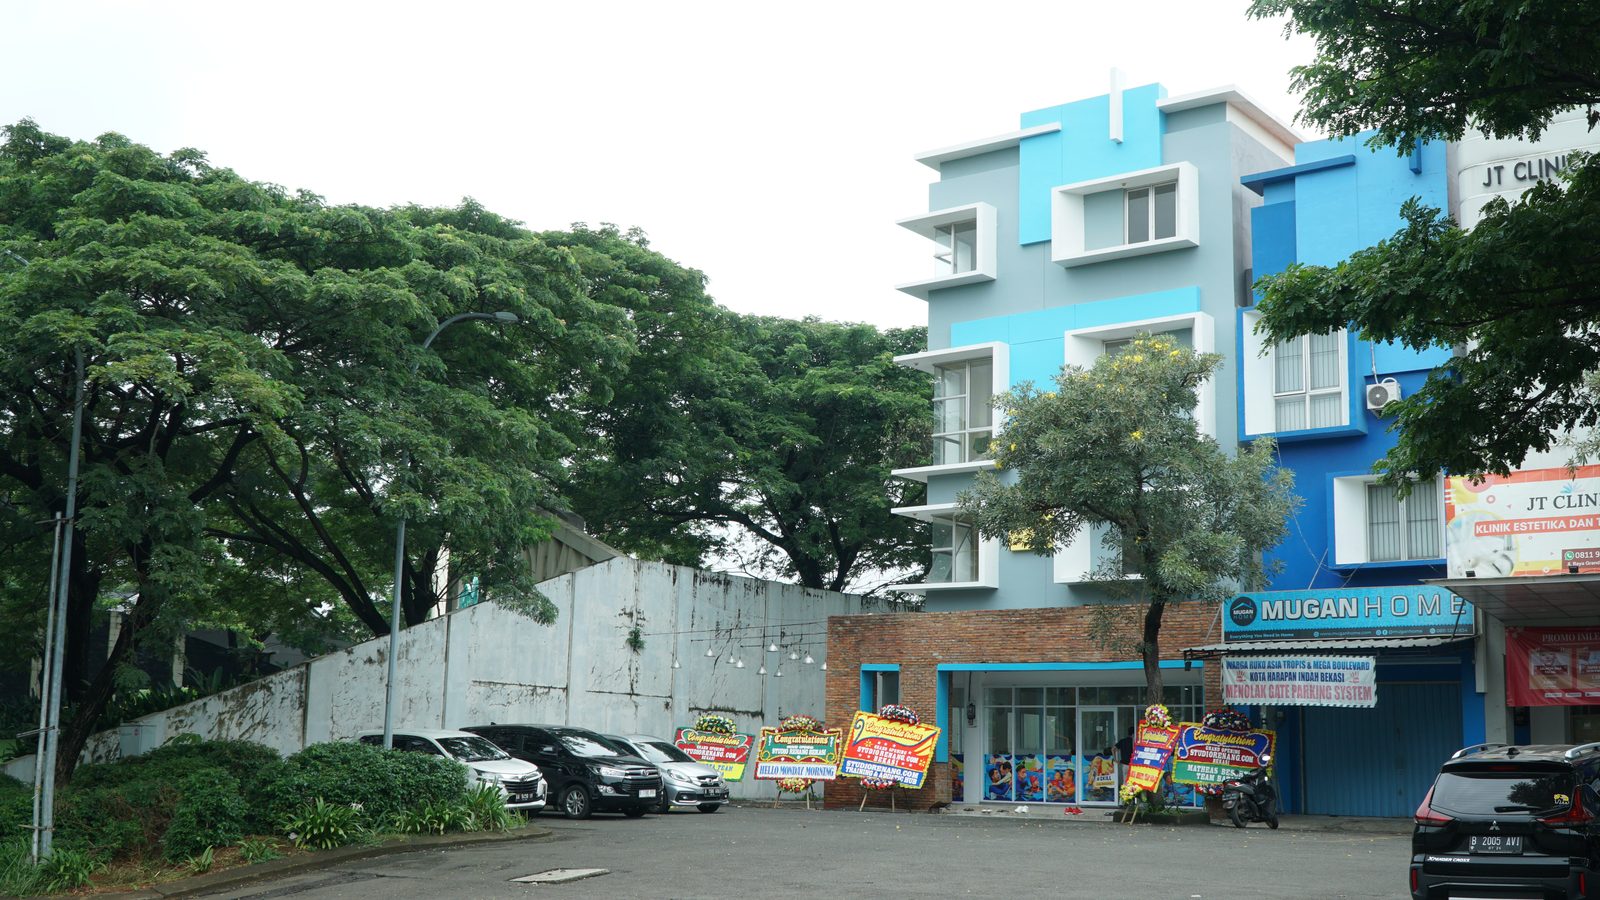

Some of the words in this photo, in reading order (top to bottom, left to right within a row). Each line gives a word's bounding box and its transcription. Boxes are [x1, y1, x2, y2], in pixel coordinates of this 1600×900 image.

[1482, 165, 1504, 187] JT
[1527, 496, 1548, 511] JT
[1553, 492, 1600, 509] CLIN
[1475, 522, 1510, 534] KLINIK
[1513, 519, 1566, 531] ESTETIKA
[1569, 518, 1594, 528] DAN
[1575, 551, 1593, 559] 0811
[1261, 597, 1358, 620] MUGAN
[1364, 593, 1467, 618] HOME
[1542, 633, 1575, 642] PROMO
[1226, 661, 1248, 670] WARGA
[1249, 660, 1267, 669] RUKO
[1267, 660, 1281, 669] ASIA
[1283, 660, 1306, 670] TROPIS
[1307, 661, 1312, 669] &
[1313, 661, 1331, 670] MEGA
[1332, 661, 1370, 670] BOULEVARD
[1250, 671, 1267, 681] KOTA
[1267, 671, 1297, 682] HARAPAN
[1298, 672, 1319, 682] INDAH
[1320, 672, 1345, 682] BEKASI
[1225, 684, 1267, 699] MENOLAK
[1268, 684, 1290, 699] GATE
[1291, 684, 1332, 700] PARKING
[1334, 685, 1372, 700] SYSTEM
[865, 721, 923, 741] Congratulations
[1193, 729, 1256, 746] Congratulations
[687, 731, 740, 746] Congratulations
[774, 735, 829, 744] Congratulations
[873, 755, 899, 766] BEKASI
[1190, 749, 1254, 763] STUDIORENANG.COM
[760, 765, 779, 774] HELLO
[780, 765, 805, 776] MONDAY
[805, 766, 834, 777] MORNING
[845, 760, 919, 779] STUDIORENANG.COM
[845, 766, 873, 778] TRAINING
[904, 777, 917, 785] HUB
[1187, 764, 1218, 774] MATHEAS
[1196, 772, 1215, 781] TEAM
[1471, 836, 1477, 846] B
[1482, 836, 1501, 846] 2005
[1505, 836, 1520, 846] AVI
